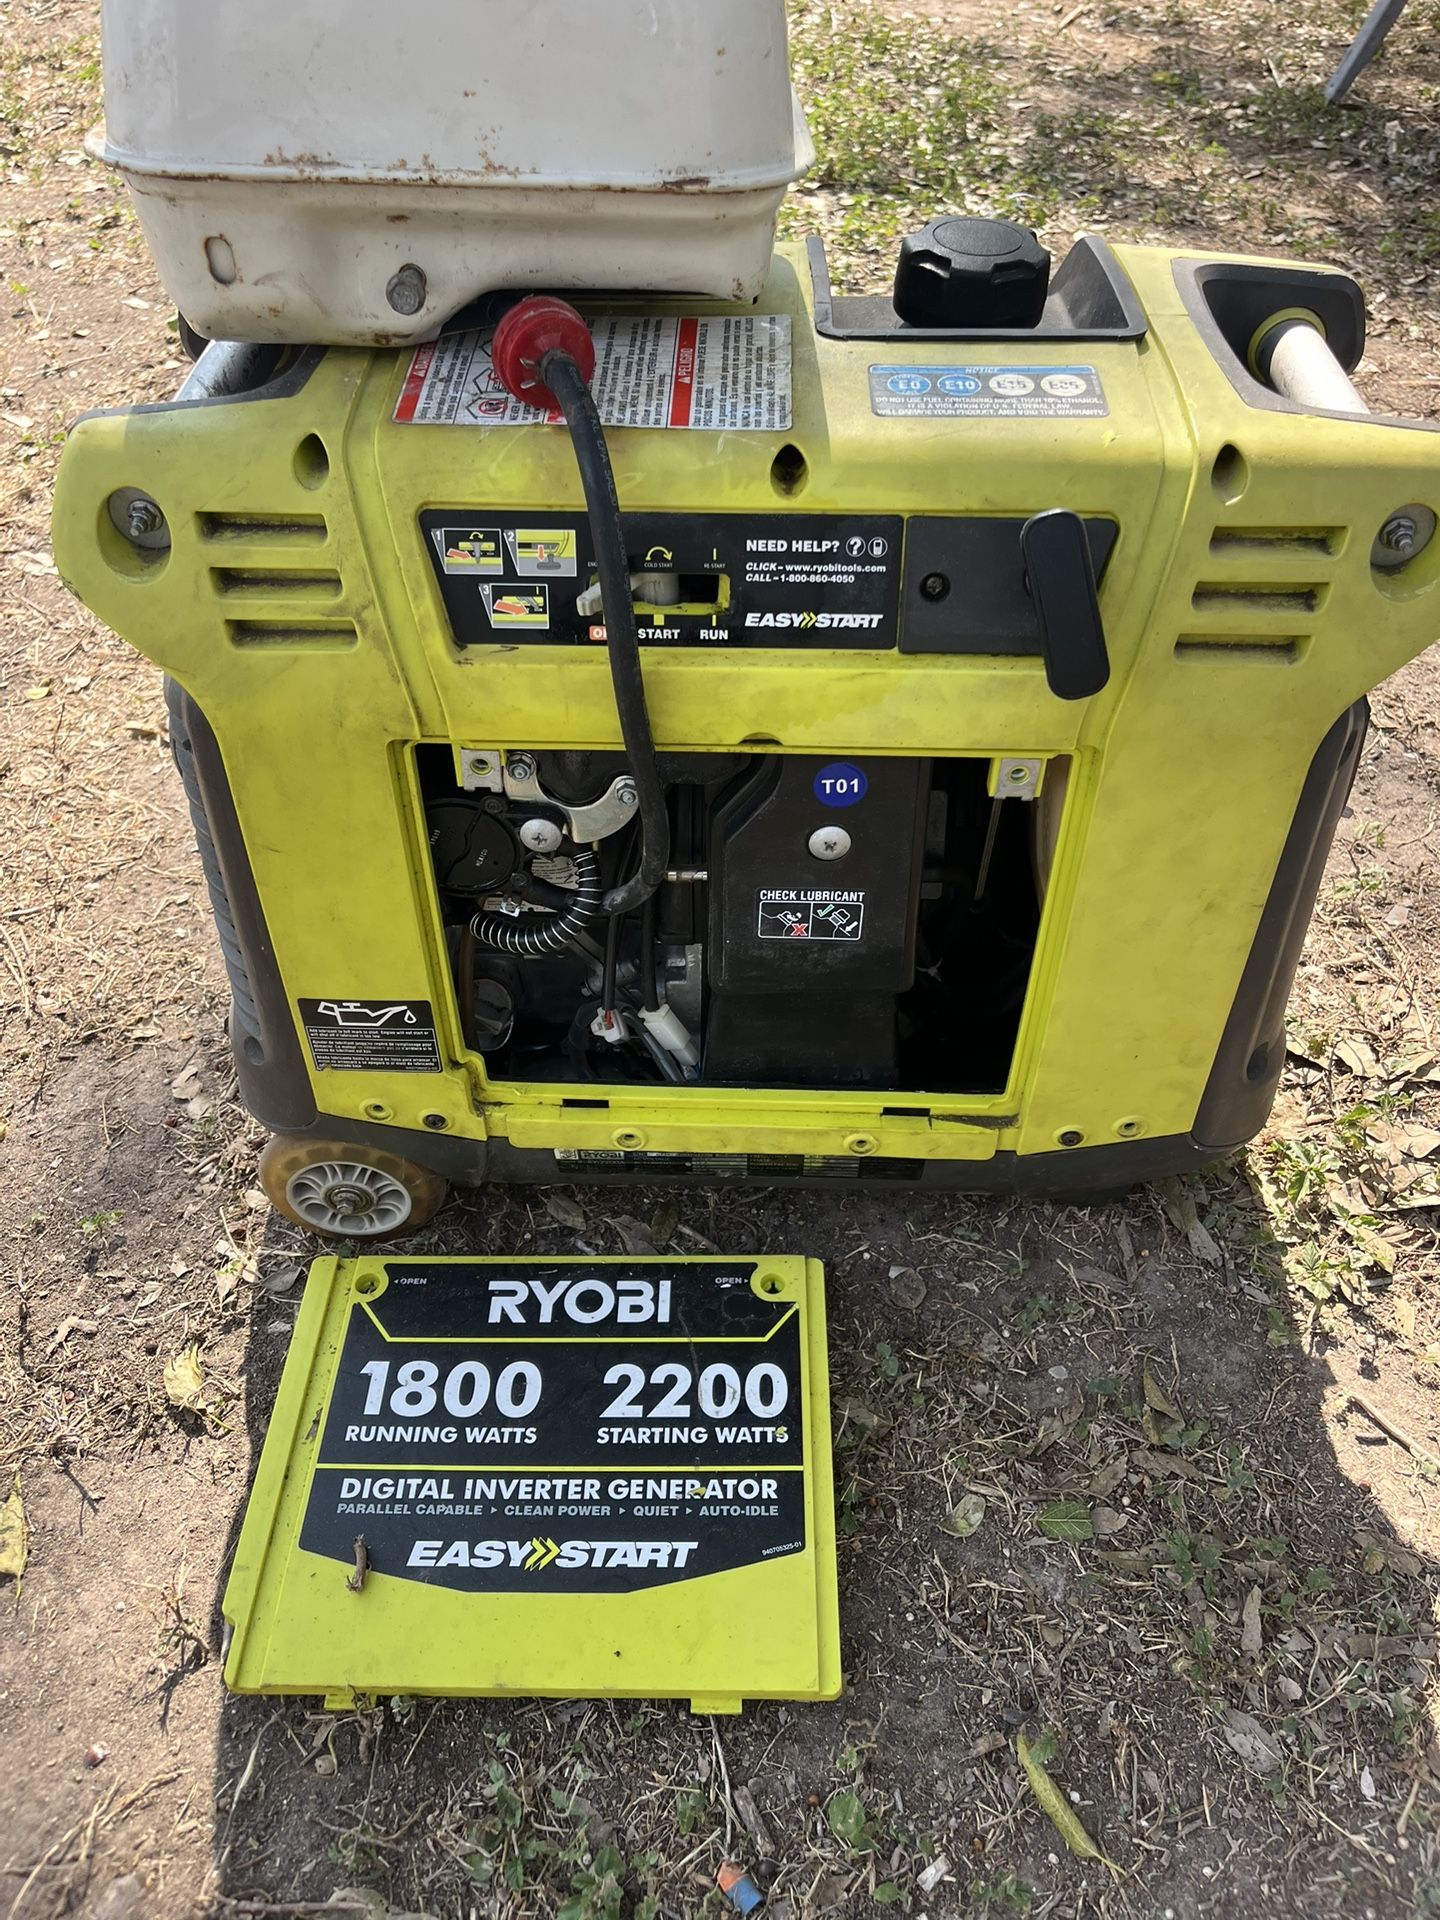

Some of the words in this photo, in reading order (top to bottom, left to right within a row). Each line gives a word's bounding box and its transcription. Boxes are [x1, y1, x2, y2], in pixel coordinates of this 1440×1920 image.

[678, 347, 693, 376] PELIGRO
[945, 380, 976, 390] E10
[507, 532, 515, 542] 2
[746, 539, 788, 552] NEED
[791, 539, 840, 553] HELP?
[483, 585, 490, 595] 3
[744, 613, 803, 628] EASY
[814, 613, 884, 628] START
[637, 628, 681, 640] START
[699, 629, 729, 640] RUN
[821, 778, 859, 794] T01
[759, 889, 797, 901] CHECK
[800, 891, 865, 902] LUBRICANT
[400, 1277, 428, 1285] OPEN
[714, 1276, 743, 1285] OPEN
[487, 1279, 671, 1325] RYOBI
[359, 1360, 543, 1419] 1800
[599, 1362, 789, 1419] 2200
[344, 1425, 458, 1444] RUNNING
[463, 1426, 538, 1445] WATTS
[597, 1426, 709, 1445] STARTING
[715, 1426, 789, 1445] WATTS
[339, 1477, 455, 1500] DIGITAL
[464, 1477, 601, 1500] INVERTER
[607, 1478, 778, 1500] GENERATOR
[336, 1503, 412, 1515] PARALLEL
[415, 1504, 483, 1516] CAPABLE
[504, 1504, 553, 1516] CLEAN
[557, 1505, 611, 1516] POWER
[632, 1505, 679, 1517] QUIET
[699, 1505, 779, 1516] AUTO-IDLE
[406, 1540, 535, 1568] EASY
[554, 1540, 699, 1568] START
